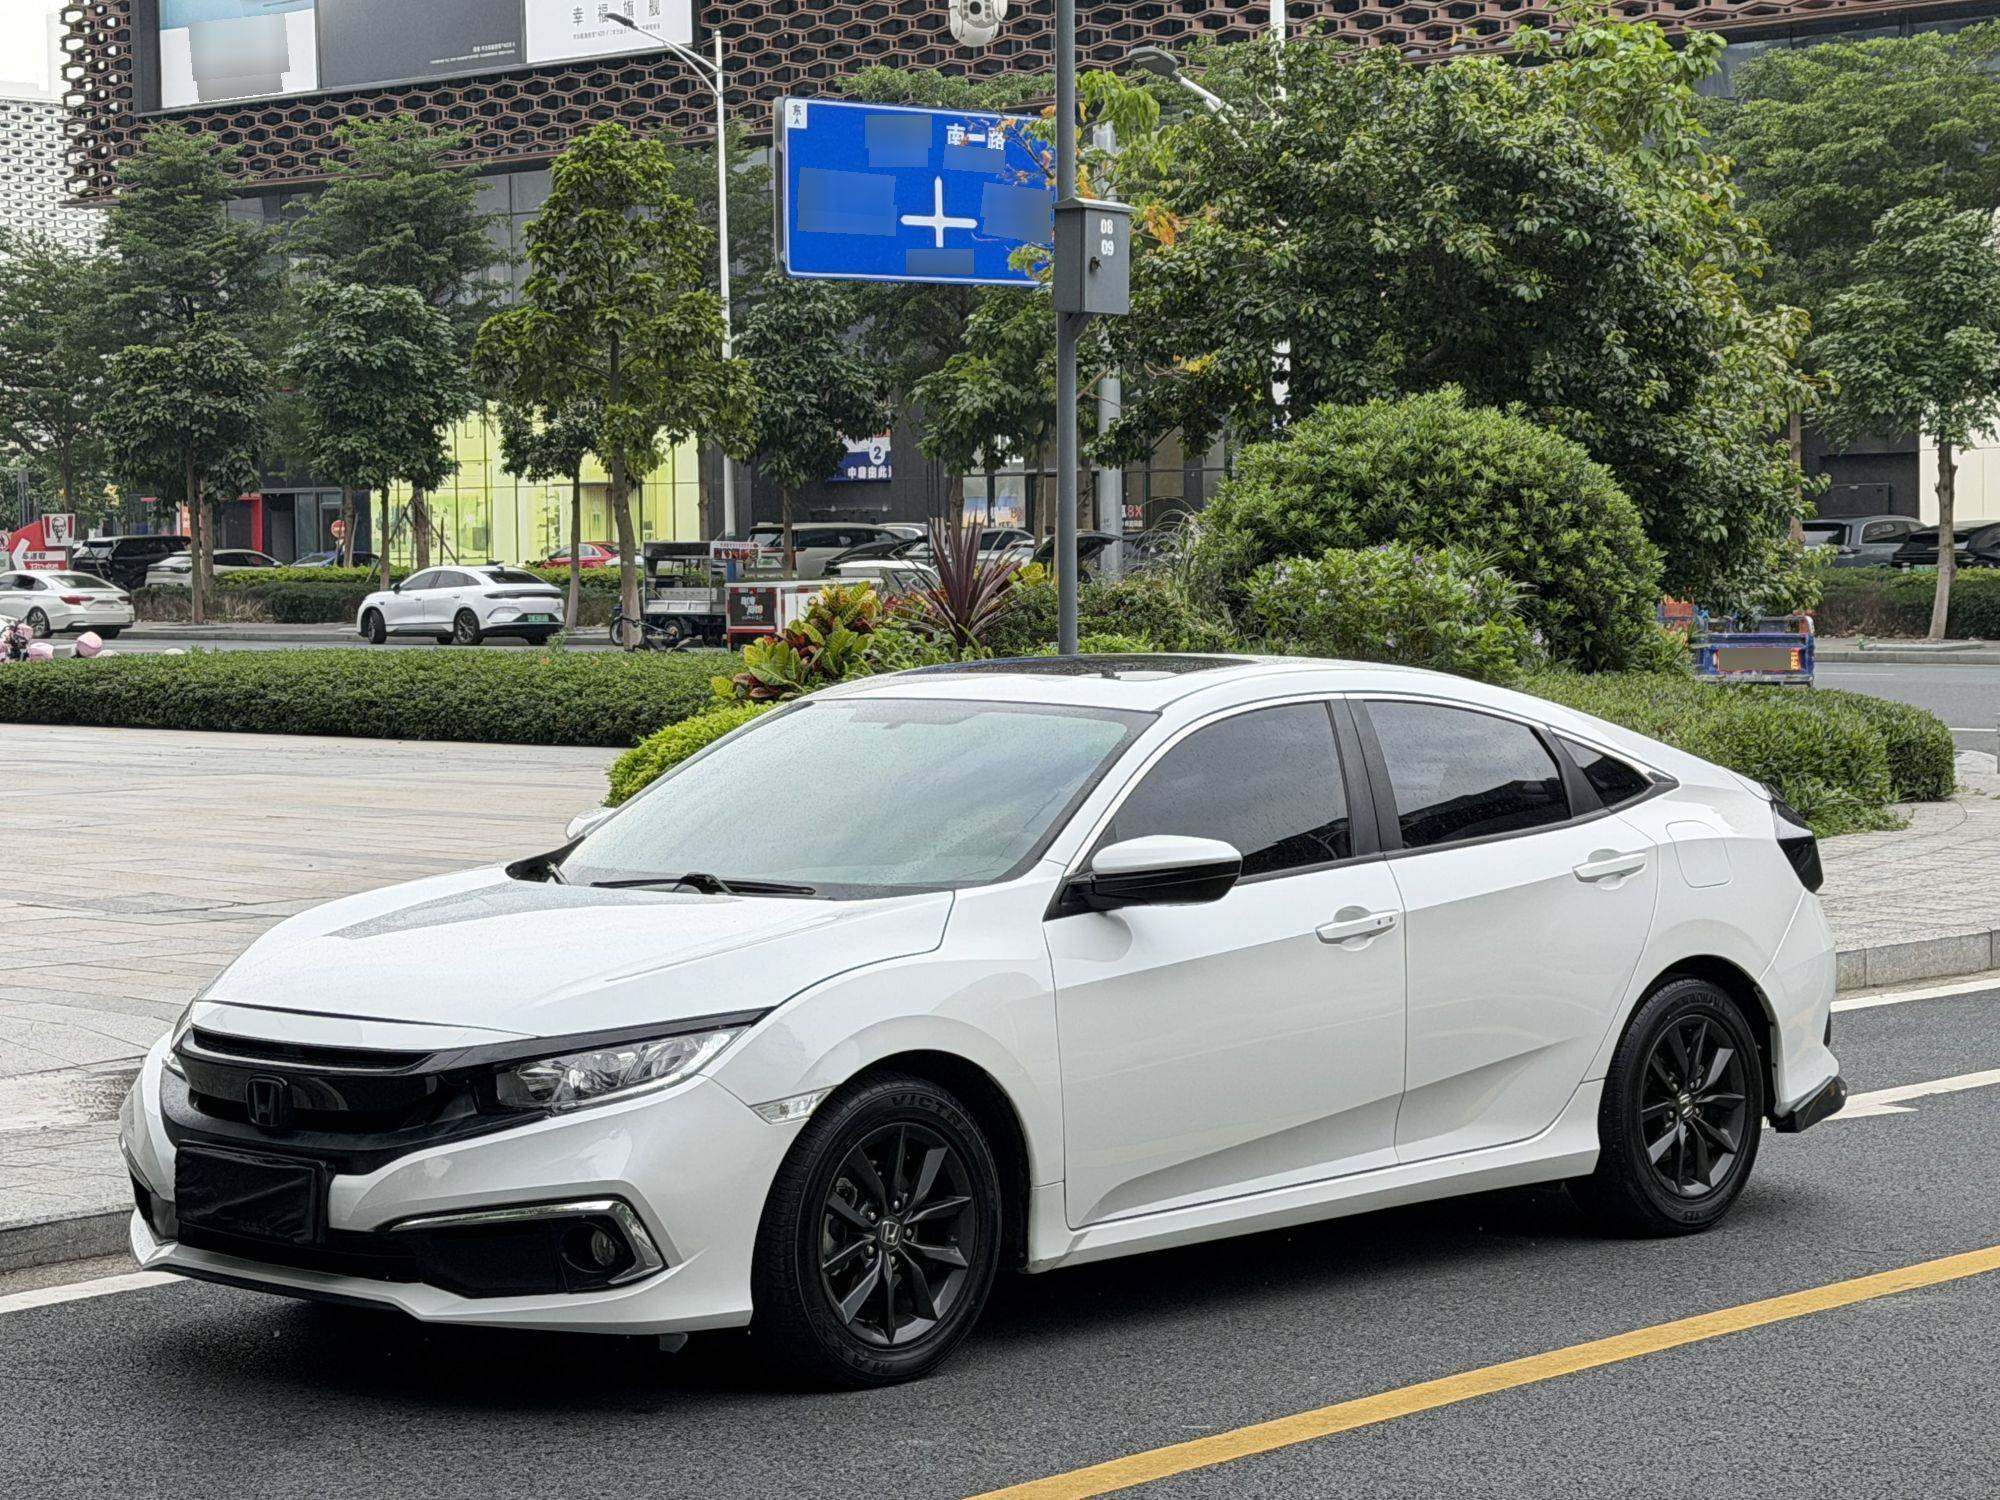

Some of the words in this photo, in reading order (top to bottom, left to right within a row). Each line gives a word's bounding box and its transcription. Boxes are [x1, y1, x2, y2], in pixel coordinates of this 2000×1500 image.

[946, 123, 1006, 150] 南一路
[1100, 218, 1114, 235] 08
[1101, 239, 1115, 256] 09
[873, 445, 882, 460] 2
